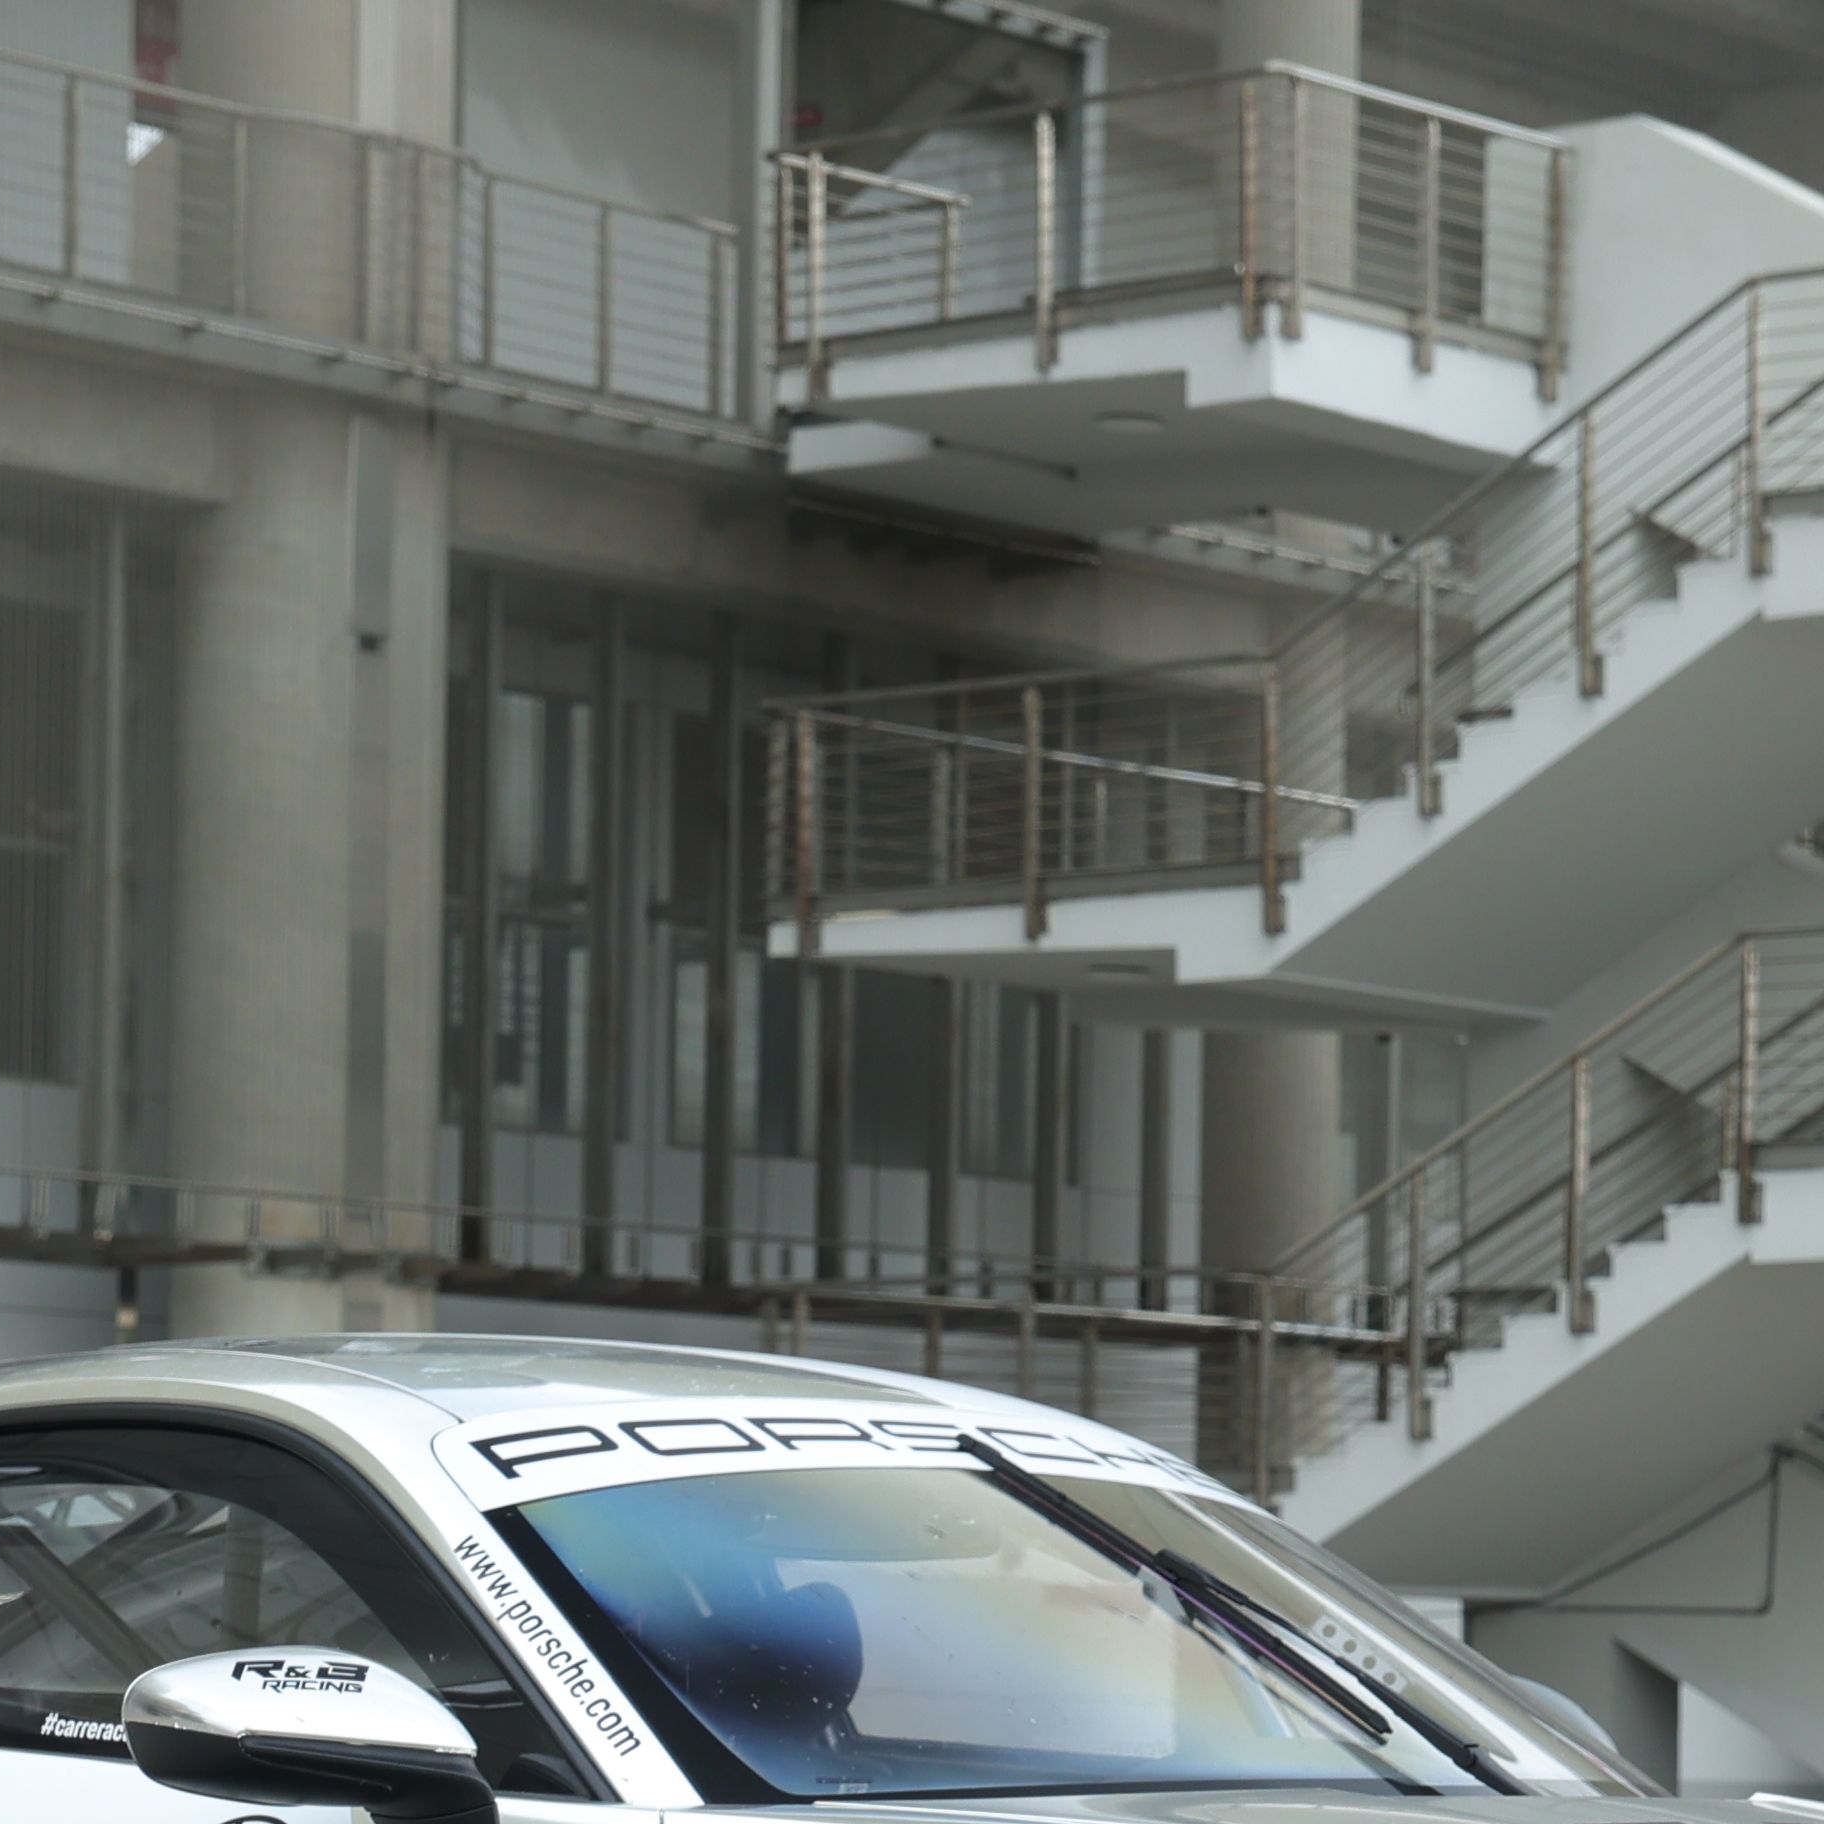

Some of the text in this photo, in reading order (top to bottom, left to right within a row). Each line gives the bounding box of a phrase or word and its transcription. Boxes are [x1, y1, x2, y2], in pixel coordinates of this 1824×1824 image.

[453, 1535, 642, 1757] www.porsche.com
[232, 1660, 370, 1682] R&B
[262, 1680, 364, 1694] RACING
